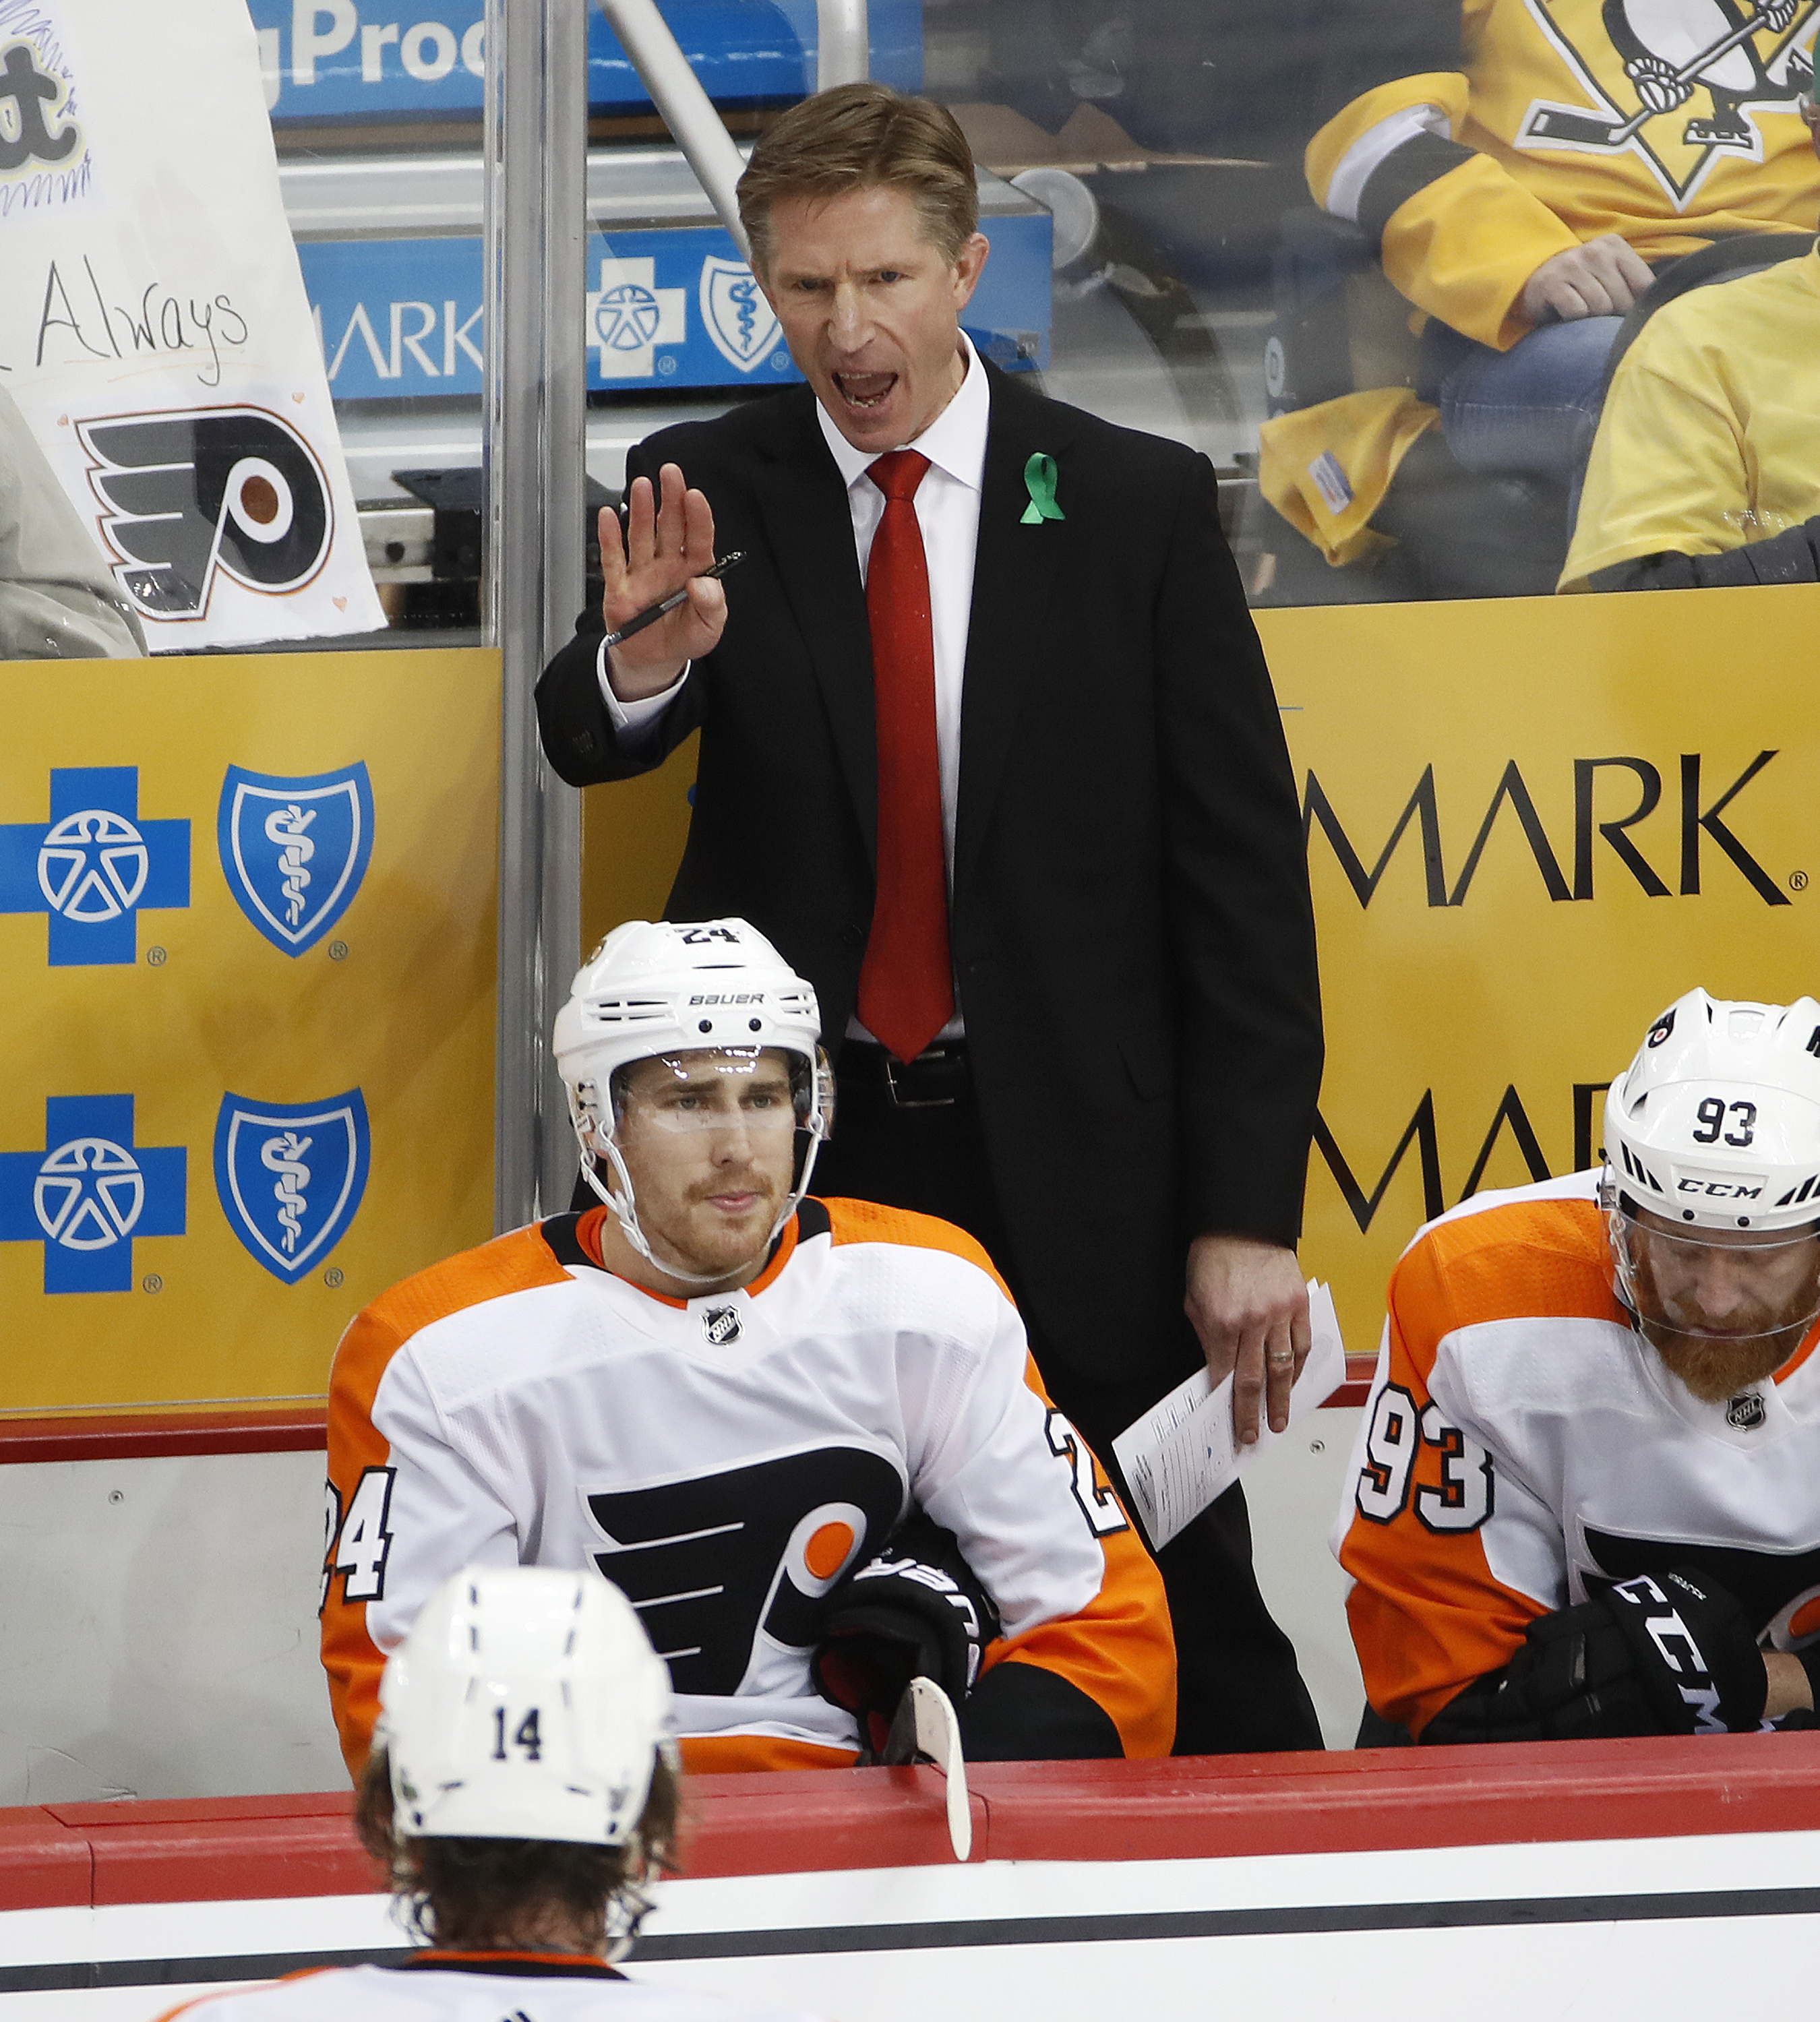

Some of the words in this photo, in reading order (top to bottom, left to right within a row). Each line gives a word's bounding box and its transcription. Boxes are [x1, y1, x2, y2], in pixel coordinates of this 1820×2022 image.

[36, 253, 248, 386] Always
[312, 301, 484, 380] ARK
[1302, 749, 1793, 910] MARK
[688, 993, 765, 1006] BAUER
[1693, 1097, 1757, 1147] 93
[1677, 1177, 1763, 1199] CCM
[1355, 1381, 1494, 1535] 93
[1612, 1574, 1729, 1736] CCM
[492, 1705, 542, 1761] 14
